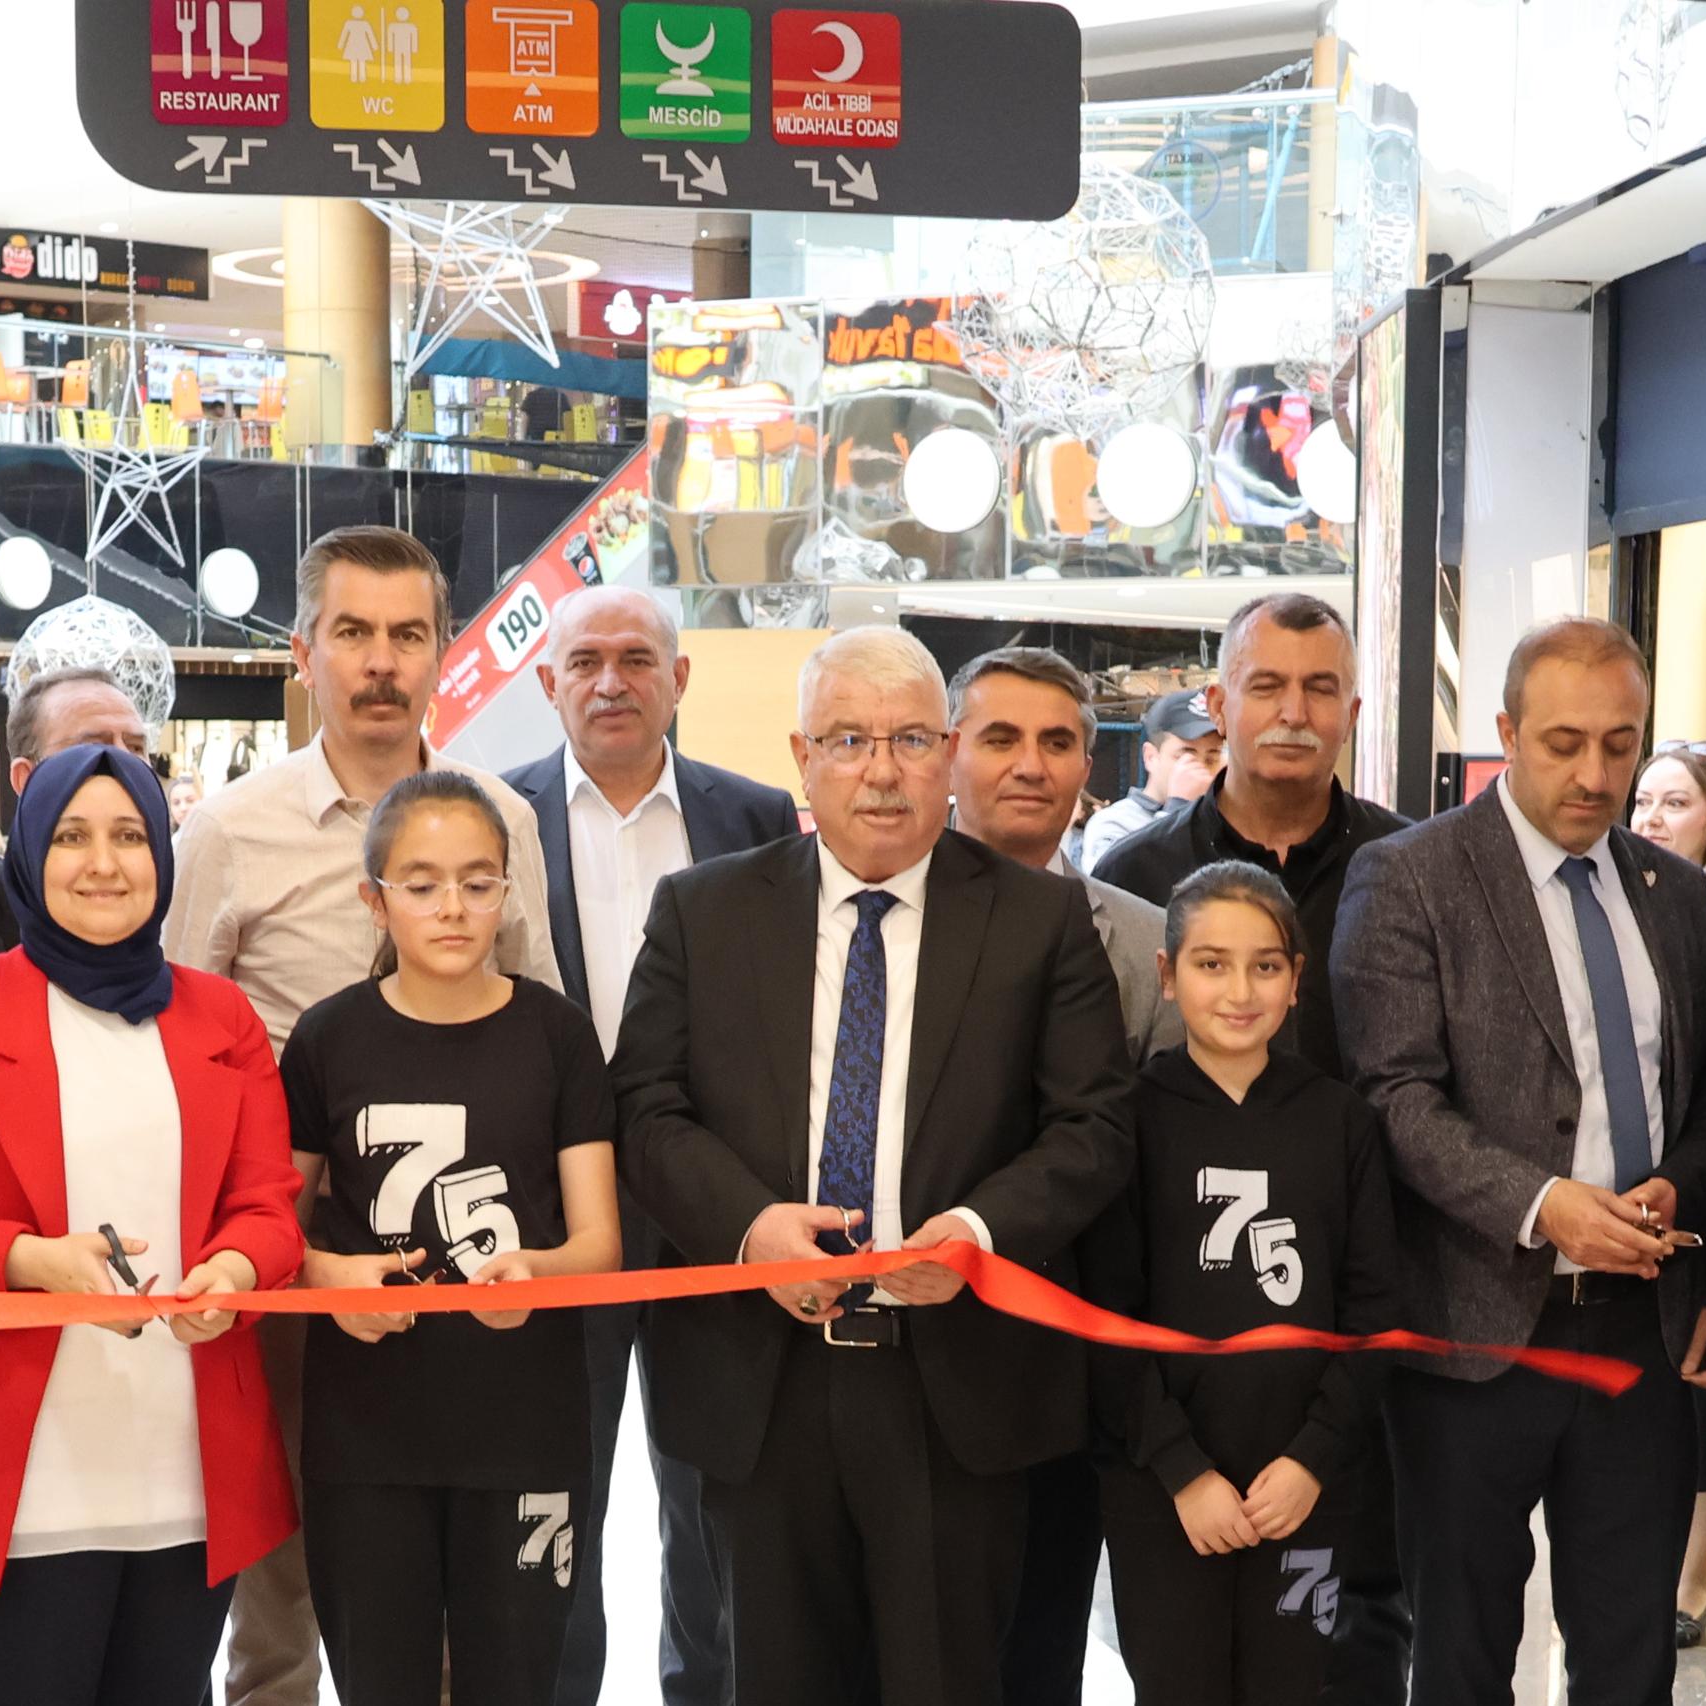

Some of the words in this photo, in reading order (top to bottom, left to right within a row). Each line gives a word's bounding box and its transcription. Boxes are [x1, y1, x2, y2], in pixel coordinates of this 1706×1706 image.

[517, 38, 550, 57] ATM
[159, 90, 280, 113] RESTAURANT
[362, 95, 395, 117] WC
[512, 104, 554, 123] ATM
[802, 91, 835, 112] ACİL
[837, 92, 872, 114] TIBBİ
[648, 104, 722, 128] MESCİD
[776, 115, 854, 137] MÜDAHALE
[856, 118, 899, 139] ODASI
[36, 234, 99, 282] dido
[497, 594, 544, 652] 190
[355, 1103, 521, 1284] 75
[1197, 1166, 1304, 1306] 75
[1276, 1546, 1341, 1638] 75
